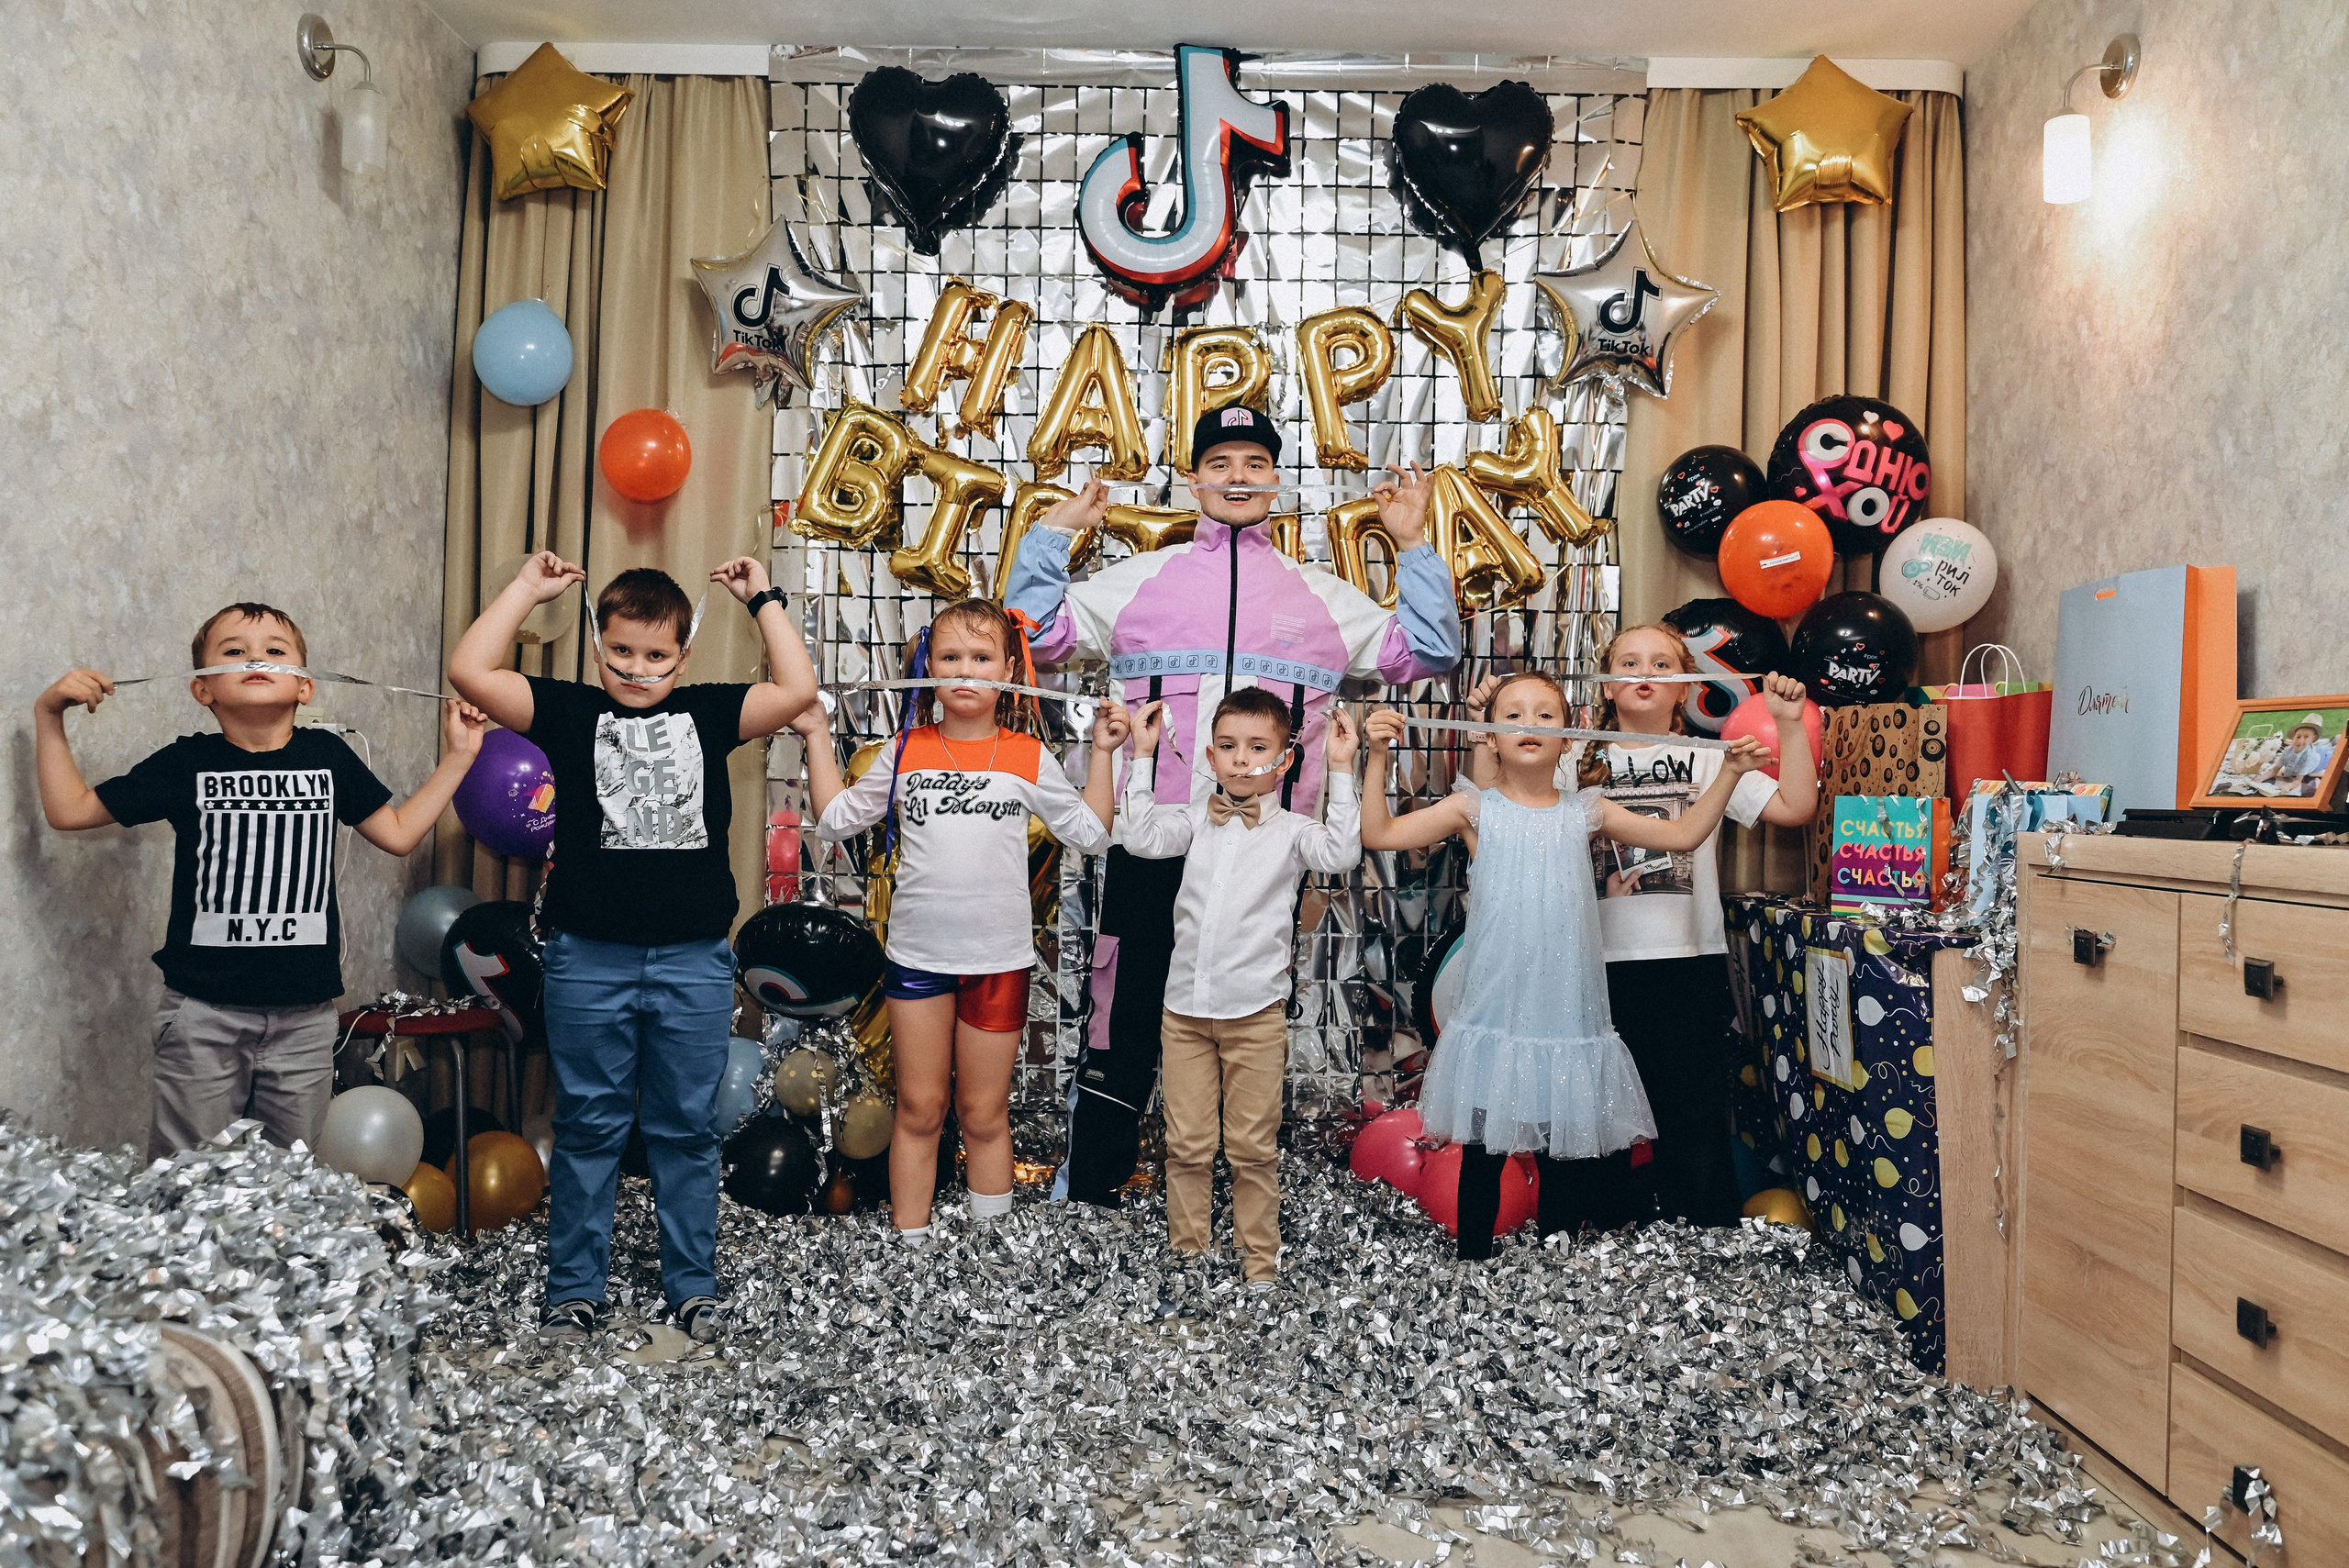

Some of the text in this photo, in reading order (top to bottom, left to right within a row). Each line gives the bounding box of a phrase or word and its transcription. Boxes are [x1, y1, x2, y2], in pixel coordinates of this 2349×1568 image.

[733, 329, 783, 351] TikTok
[1598, 338, 1650, 356] TikTok
[900, 269, 1507, 481] HAPPY
[1670, 482, 1709, 517] PARTY
[1828, 661, 1881, 685] PARTY
[626, 717, 672, 752] LE
[204, 773, 330, 797] BROOKLYN
[625, 760, 678, 795] GE
[906, 773, 991, 796] Daddy's
[904, 795, 1022, 826] Lil Monster
[626, 806, 684, 842] ND
[1839, 841, 1926, 862] СЧАСТЬЯ
[1837, 867, 1926, 888] СЧАСТЬЯ
[227, 917, 297, 942] N.Y.C
[1816, 959, 1831, 1071] Happy
